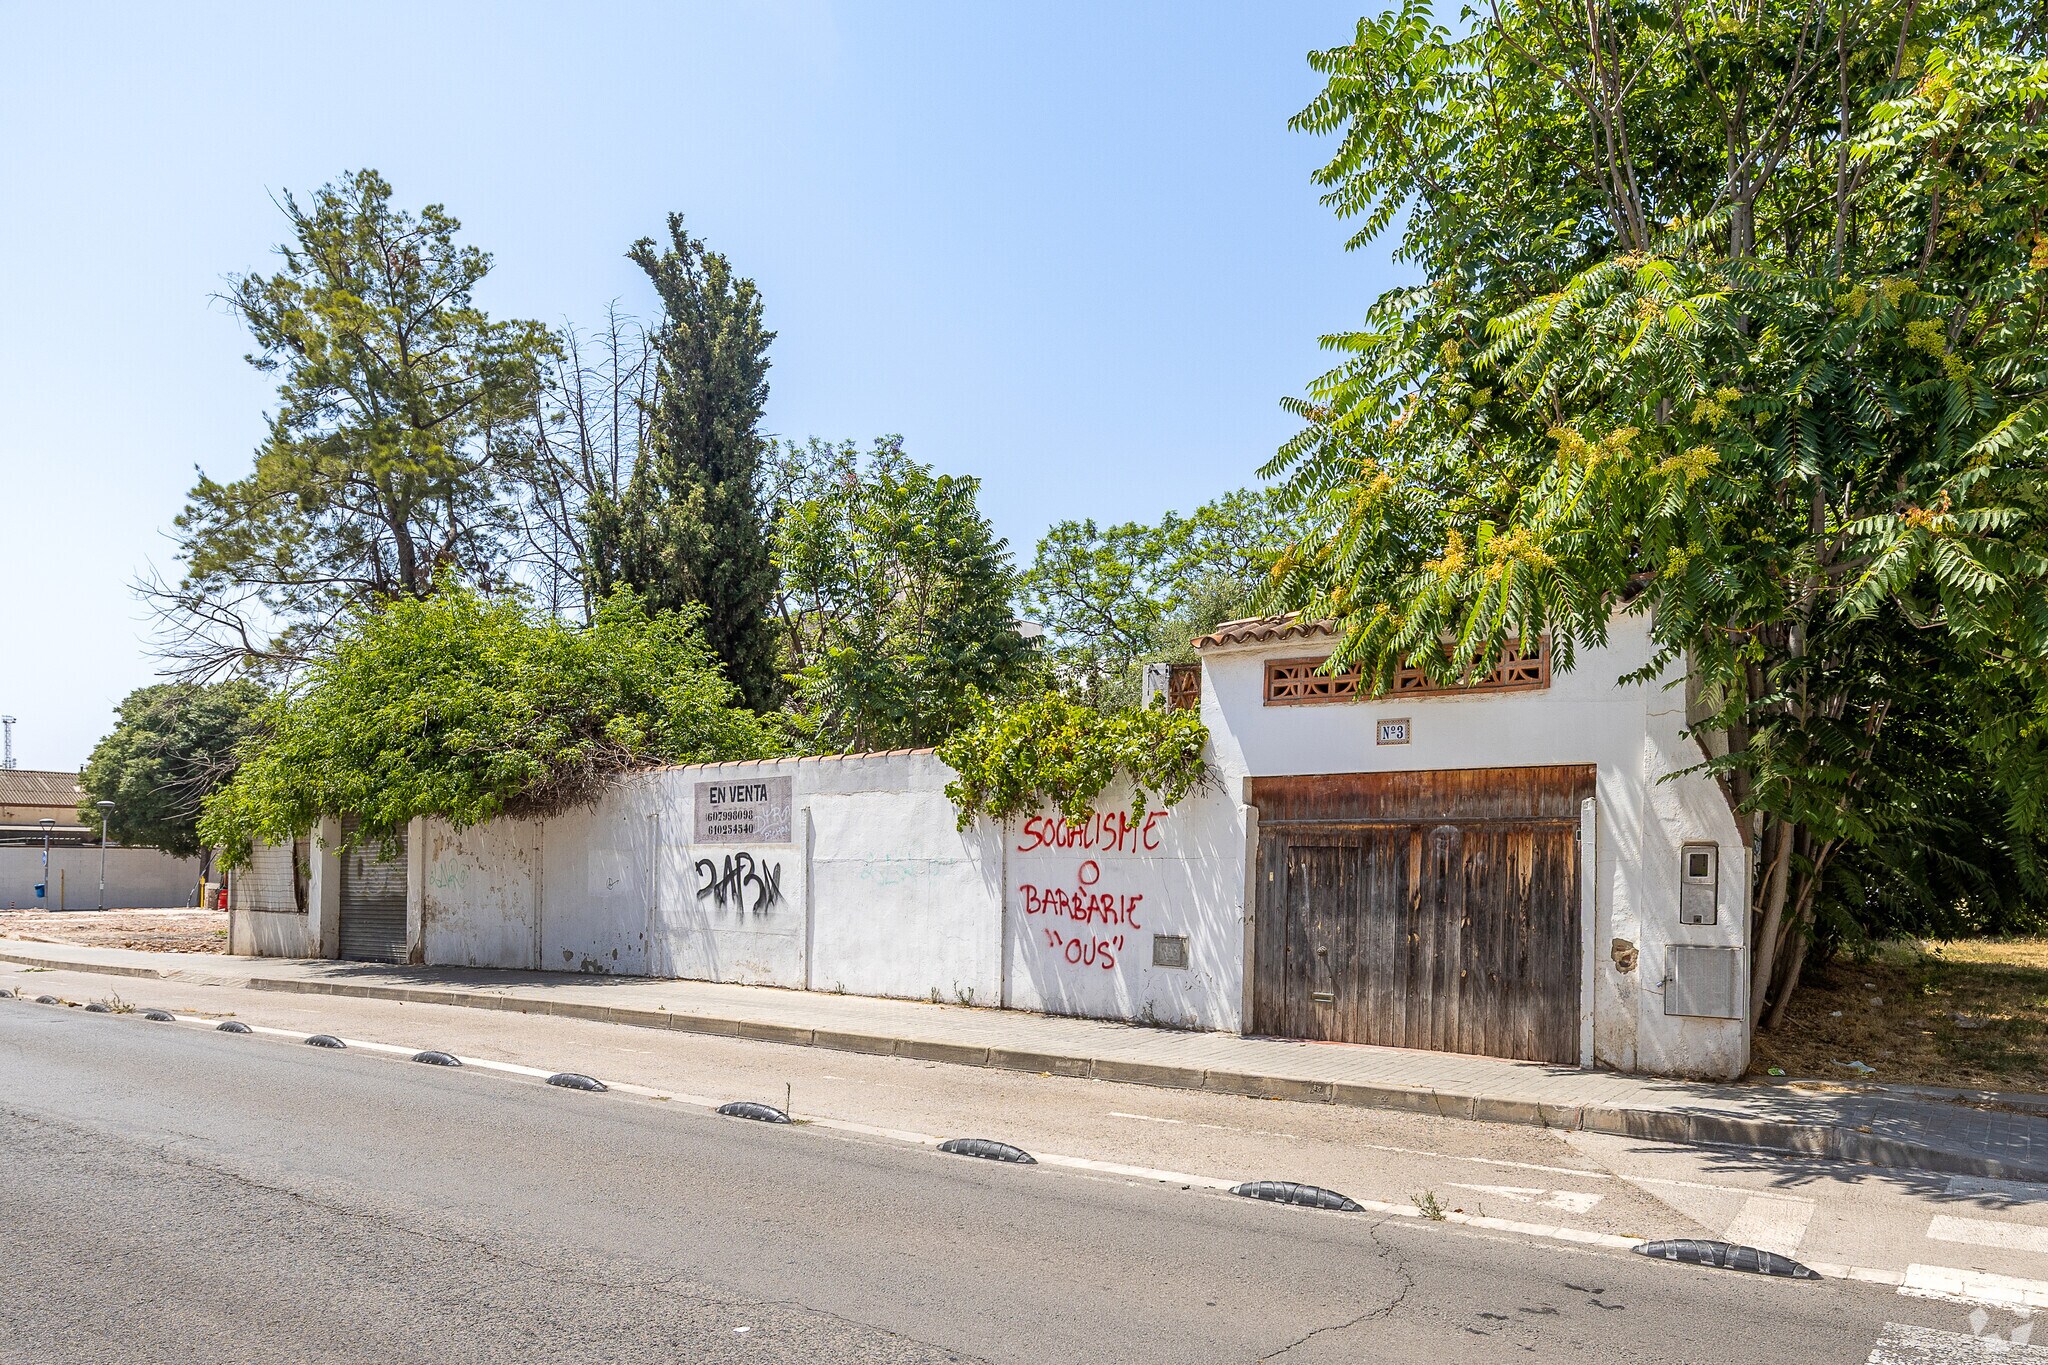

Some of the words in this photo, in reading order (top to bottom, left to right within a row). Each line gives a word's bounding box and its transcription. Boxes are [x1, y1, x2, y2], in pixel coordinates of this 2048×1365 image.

[709, 787, 726, 804] EN
[729, 784, 768, 803] VENTA
[707, 810, 754, 822] 607998098
[1078, 860, 1101, 886] O
